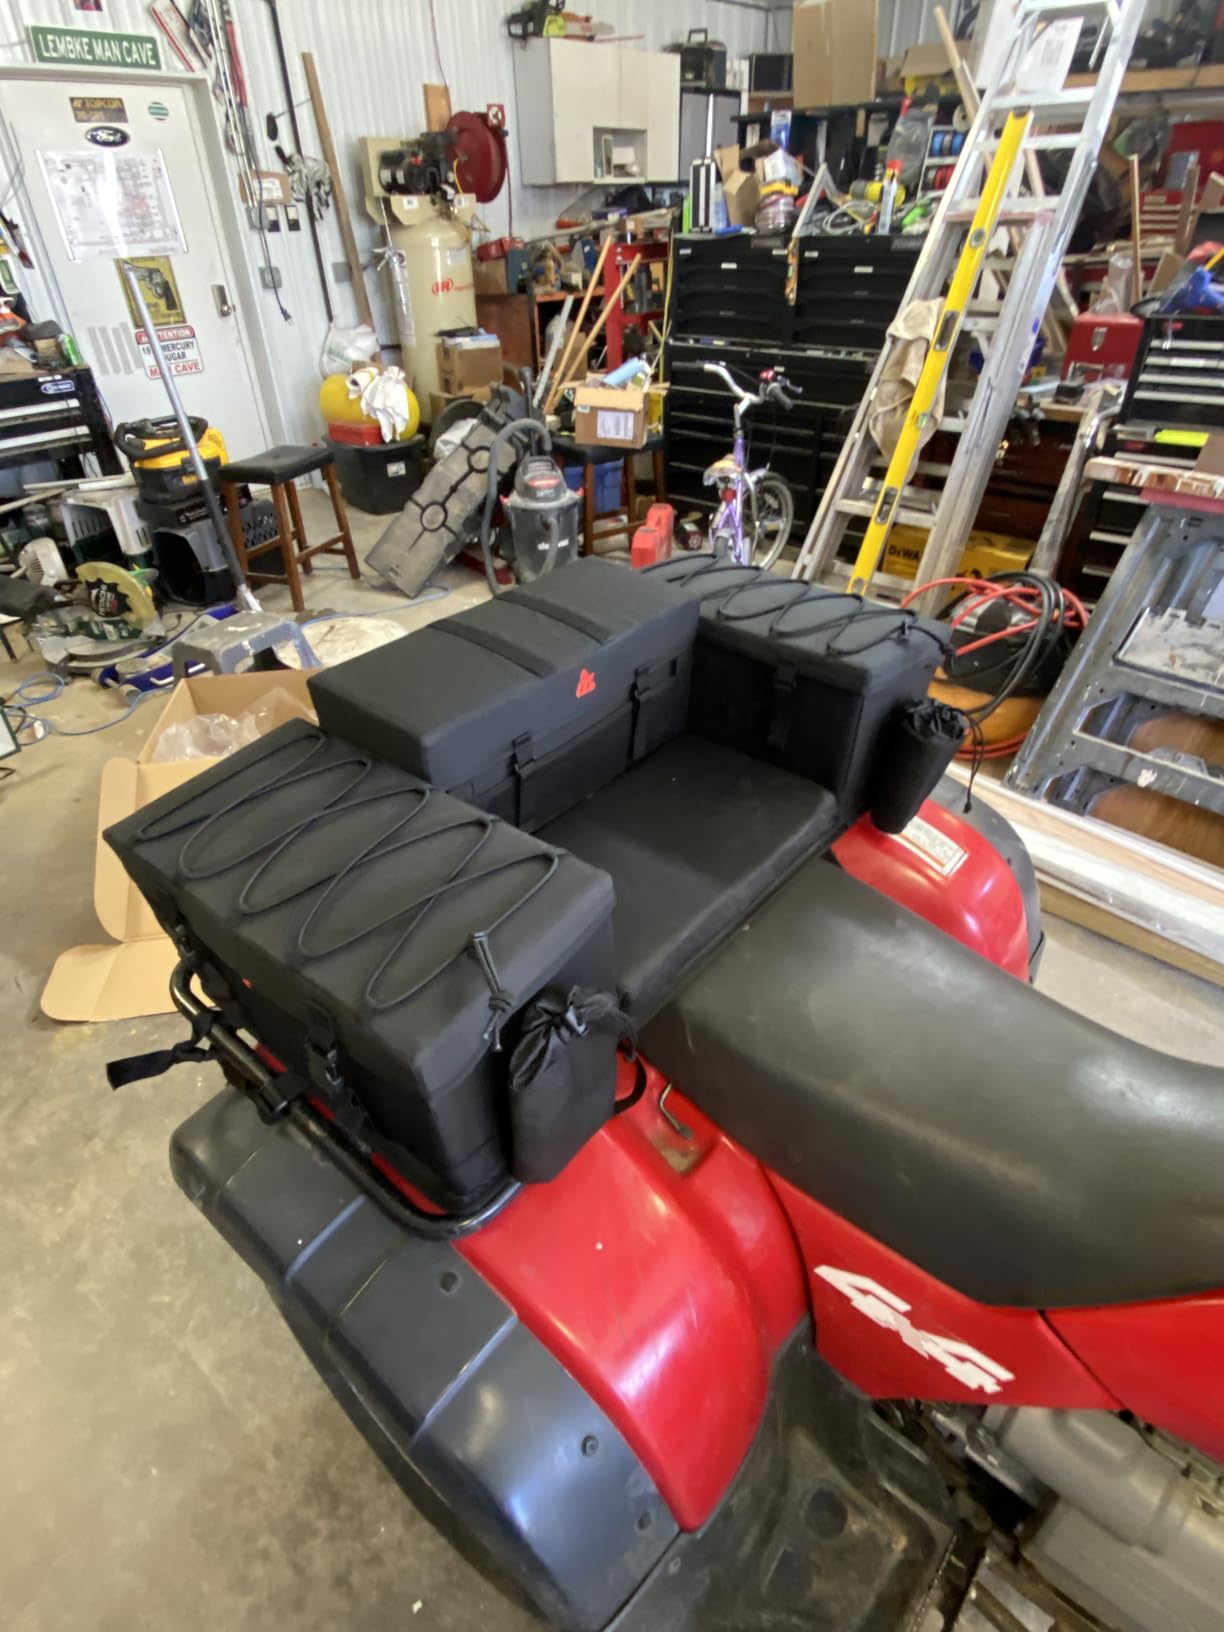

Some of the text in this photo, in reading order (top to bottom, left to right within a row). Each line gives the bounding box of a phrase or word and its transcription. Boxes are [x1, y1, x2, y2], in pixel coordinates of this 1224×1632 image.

[39, 33, 156, 65] LEMBKE MAN CAVE
[142, 329, 191, 343] ATENTION
[160, 341, 194, 352] MERCURY
[175, 362, 200, 373] CAVE
